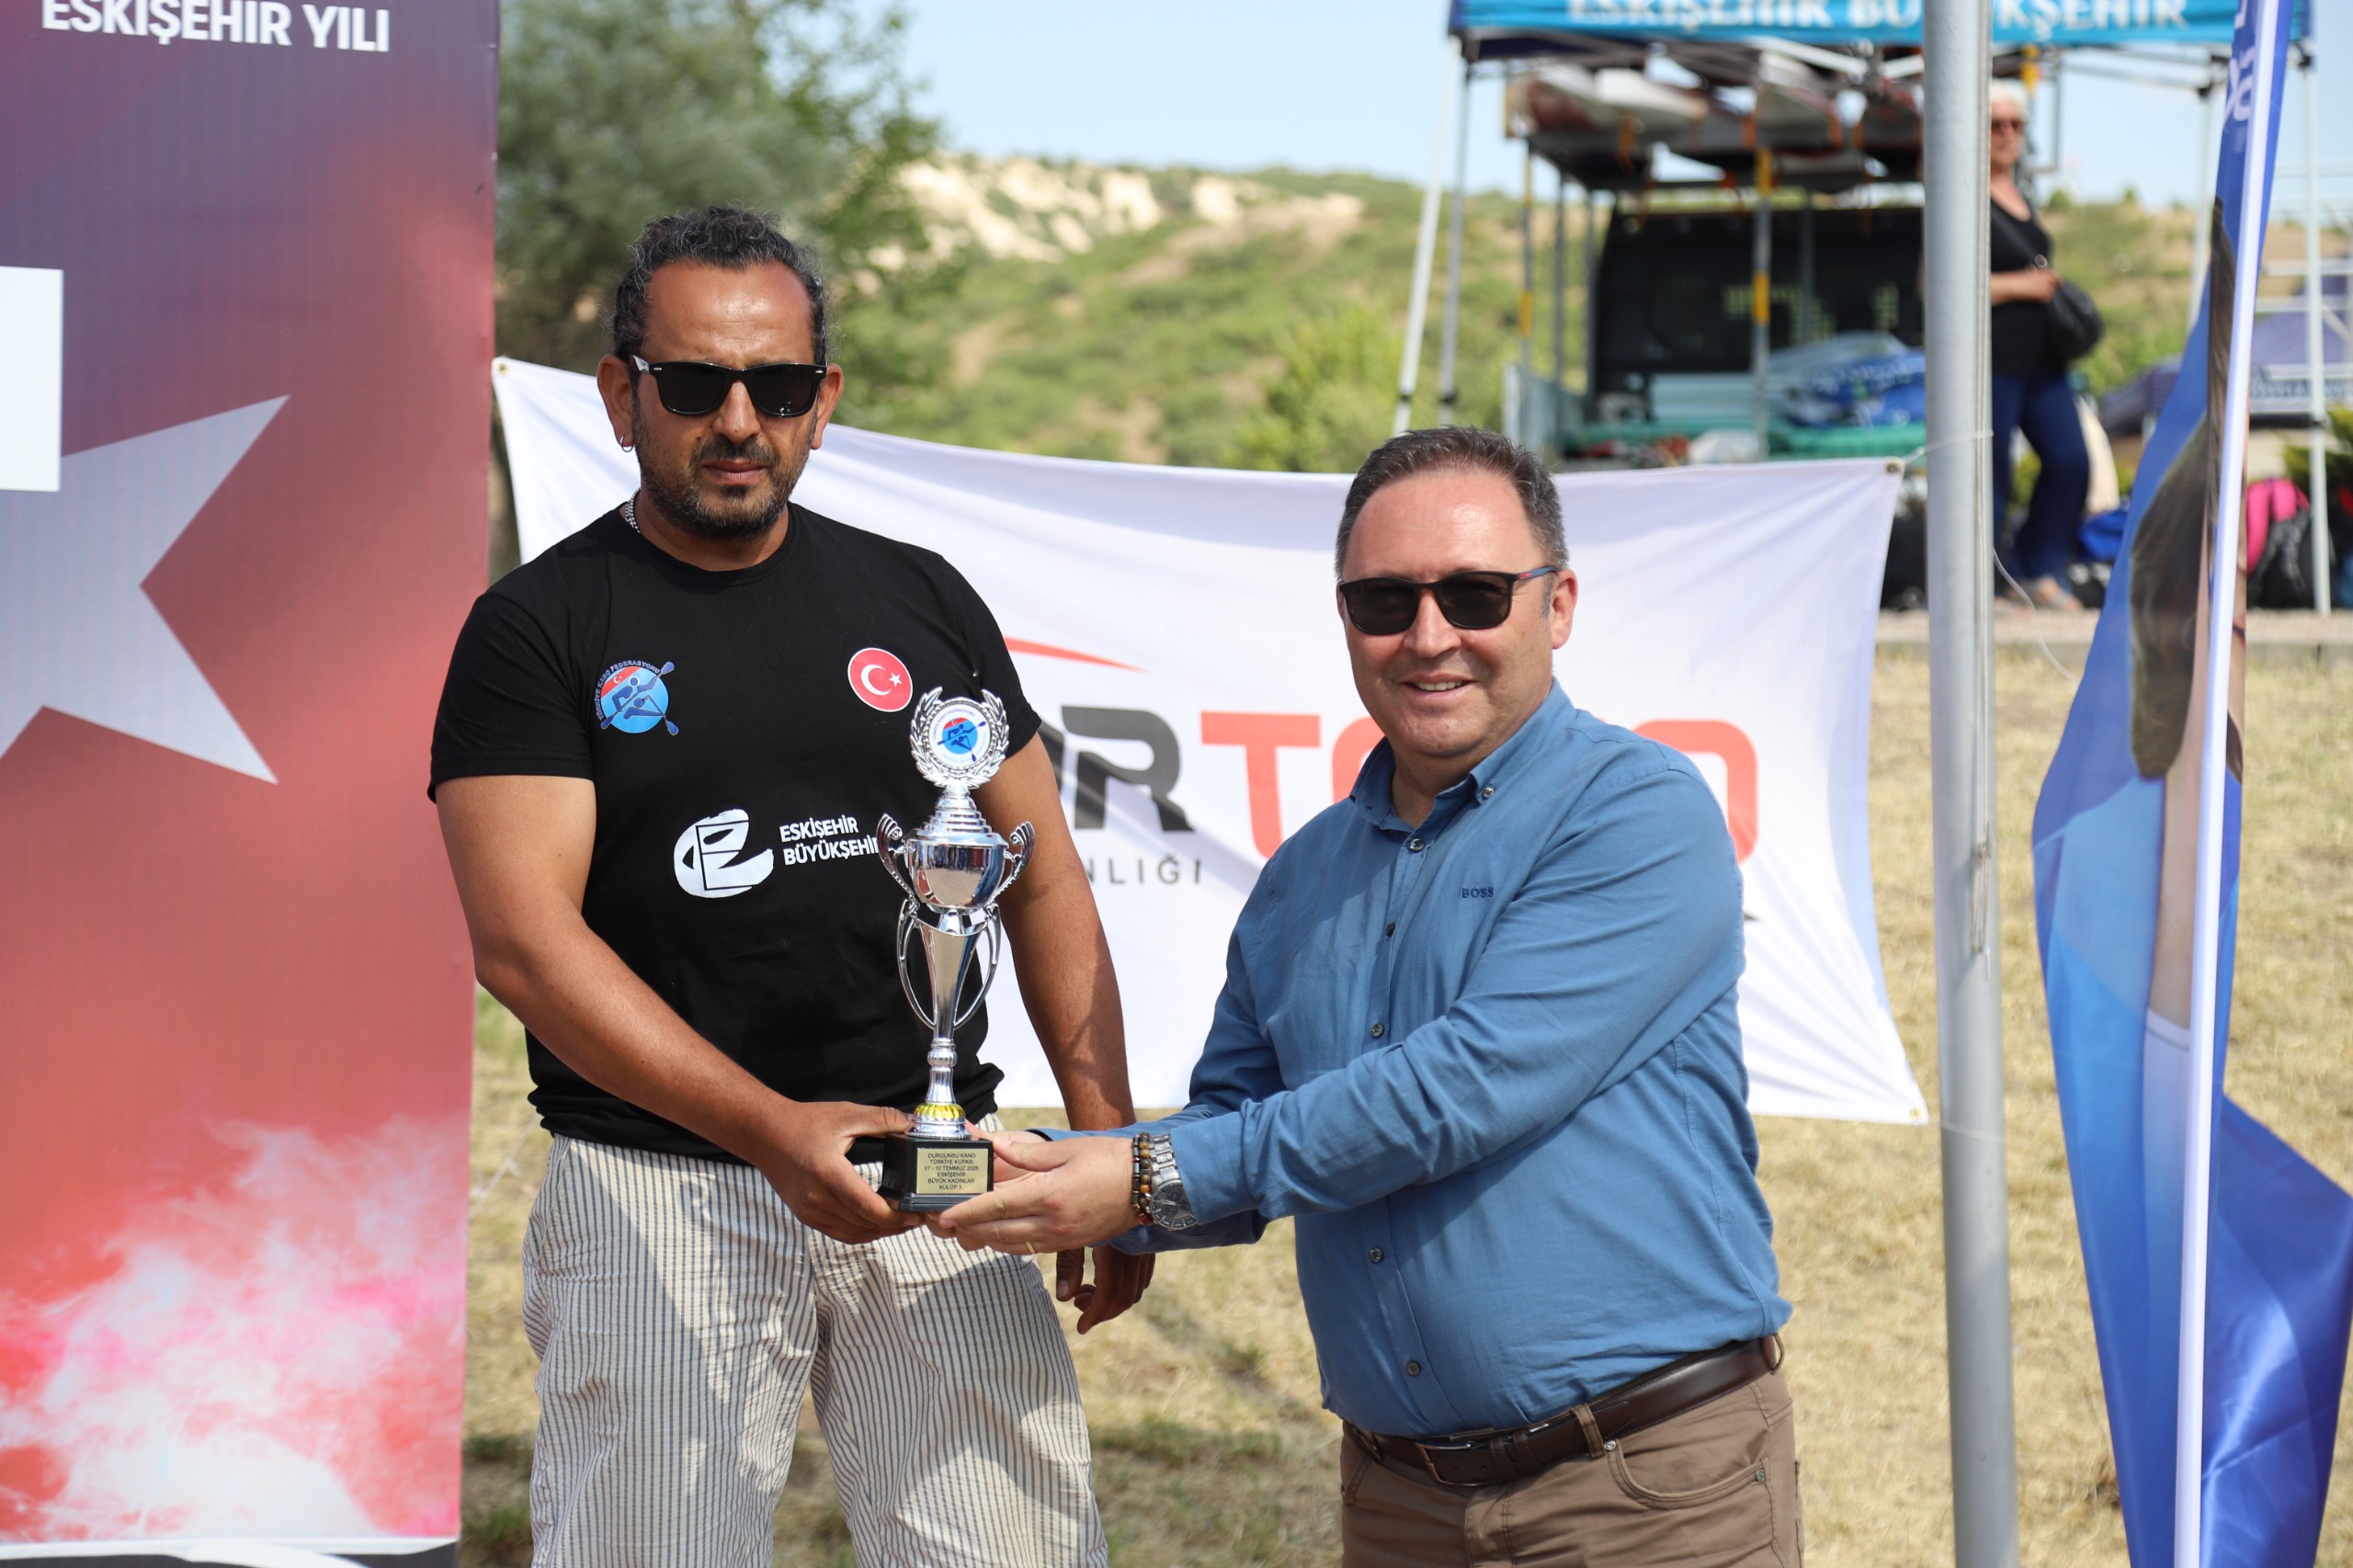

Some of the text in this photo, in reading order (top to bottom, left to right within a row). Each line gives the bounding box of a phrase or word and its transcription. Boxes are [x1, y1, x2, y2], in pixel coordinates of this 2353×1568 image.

[301, 4, 390, 52] YILI
[597, 669, 611, 687] KANO
[609, 660, 661, 674] FEDERASYONU
[779, 814, 859, 843] ESKİŞEHİR
[1461, 886, 1495, 899] BOSS
